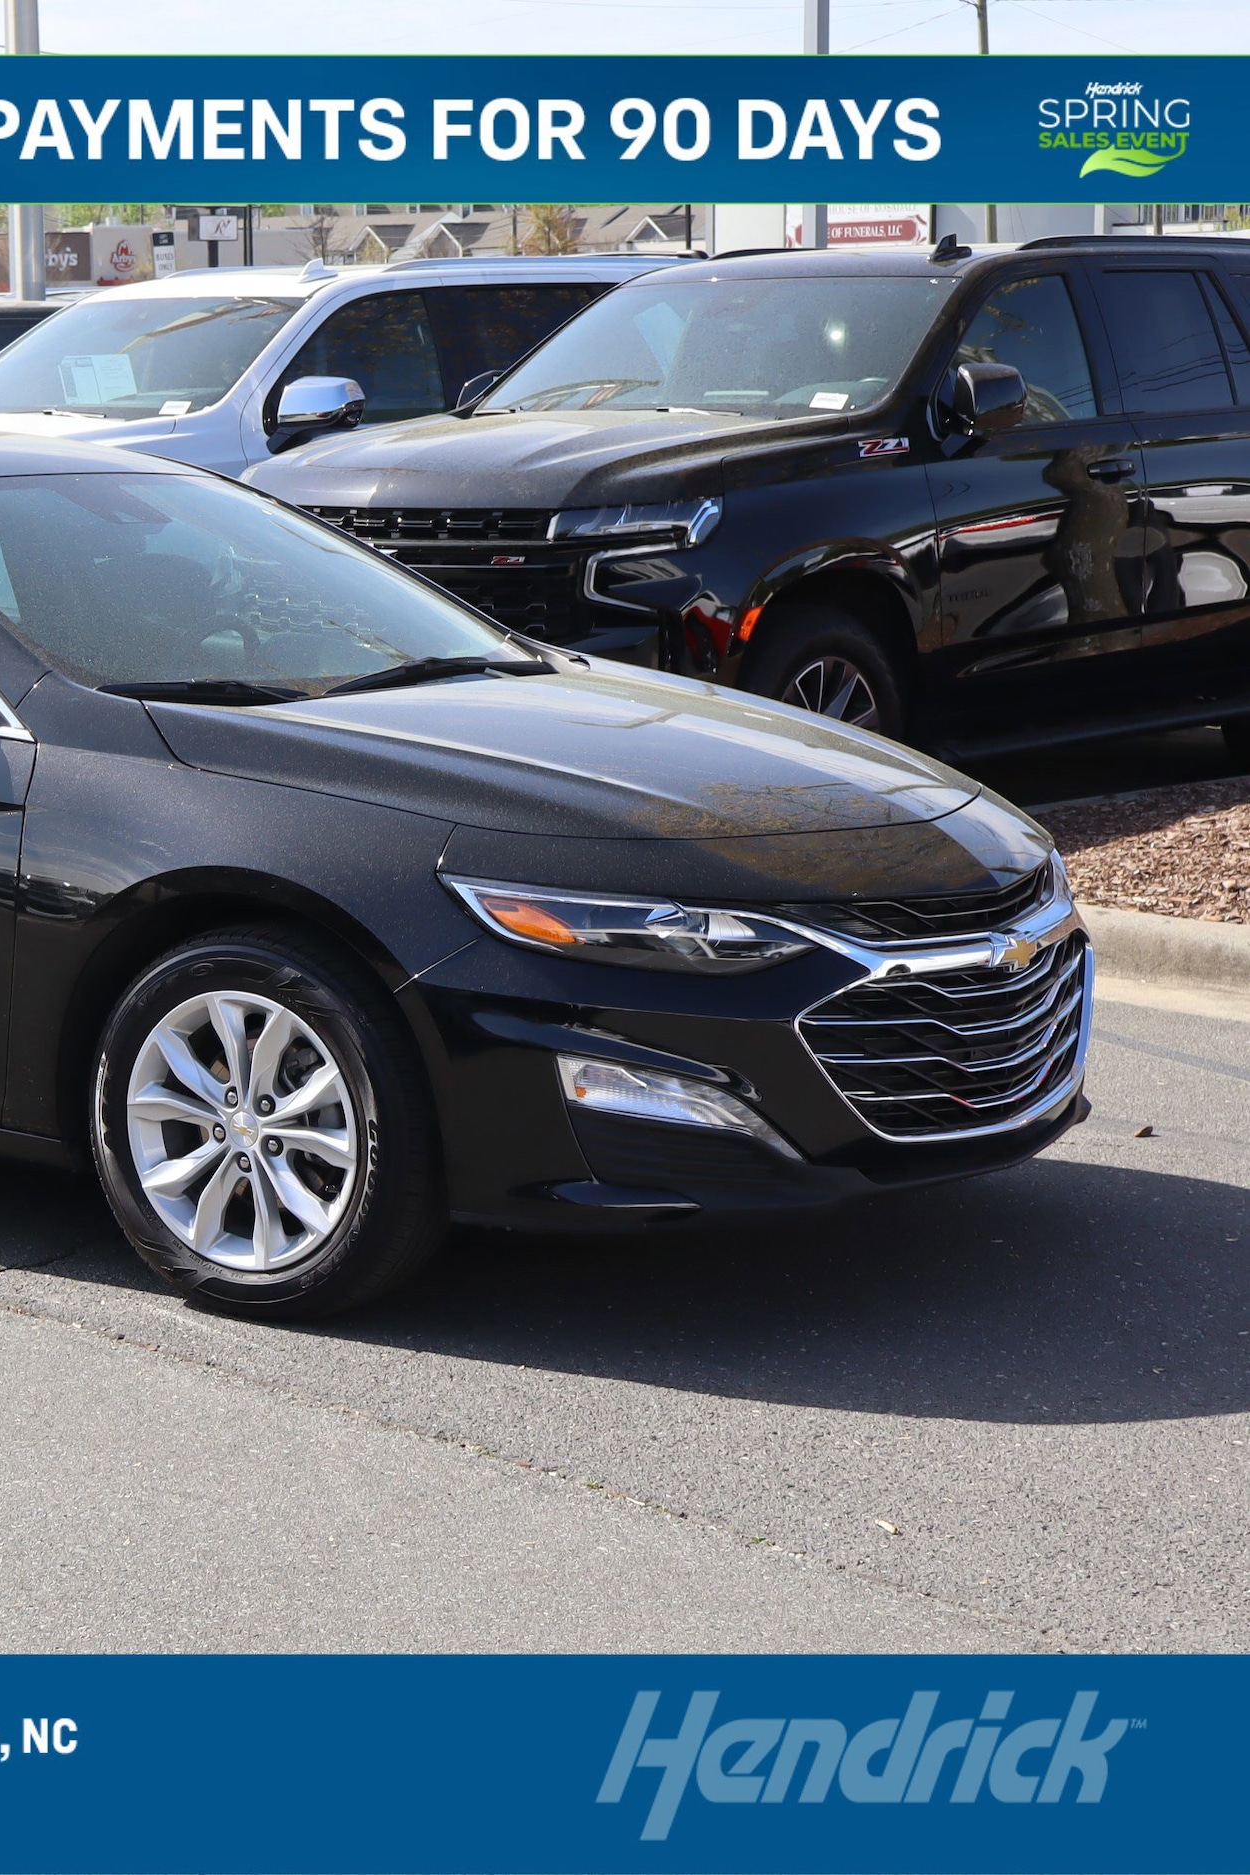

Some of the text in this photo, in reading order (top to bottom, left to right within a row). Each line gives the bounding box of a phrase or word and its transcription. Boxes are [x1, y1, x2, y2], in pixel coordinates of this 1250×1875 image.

[831, 227, 843, 239] OF
[844, 226, 886, 238] FUNERALS,
[888, 225, 903, 236] LLC
